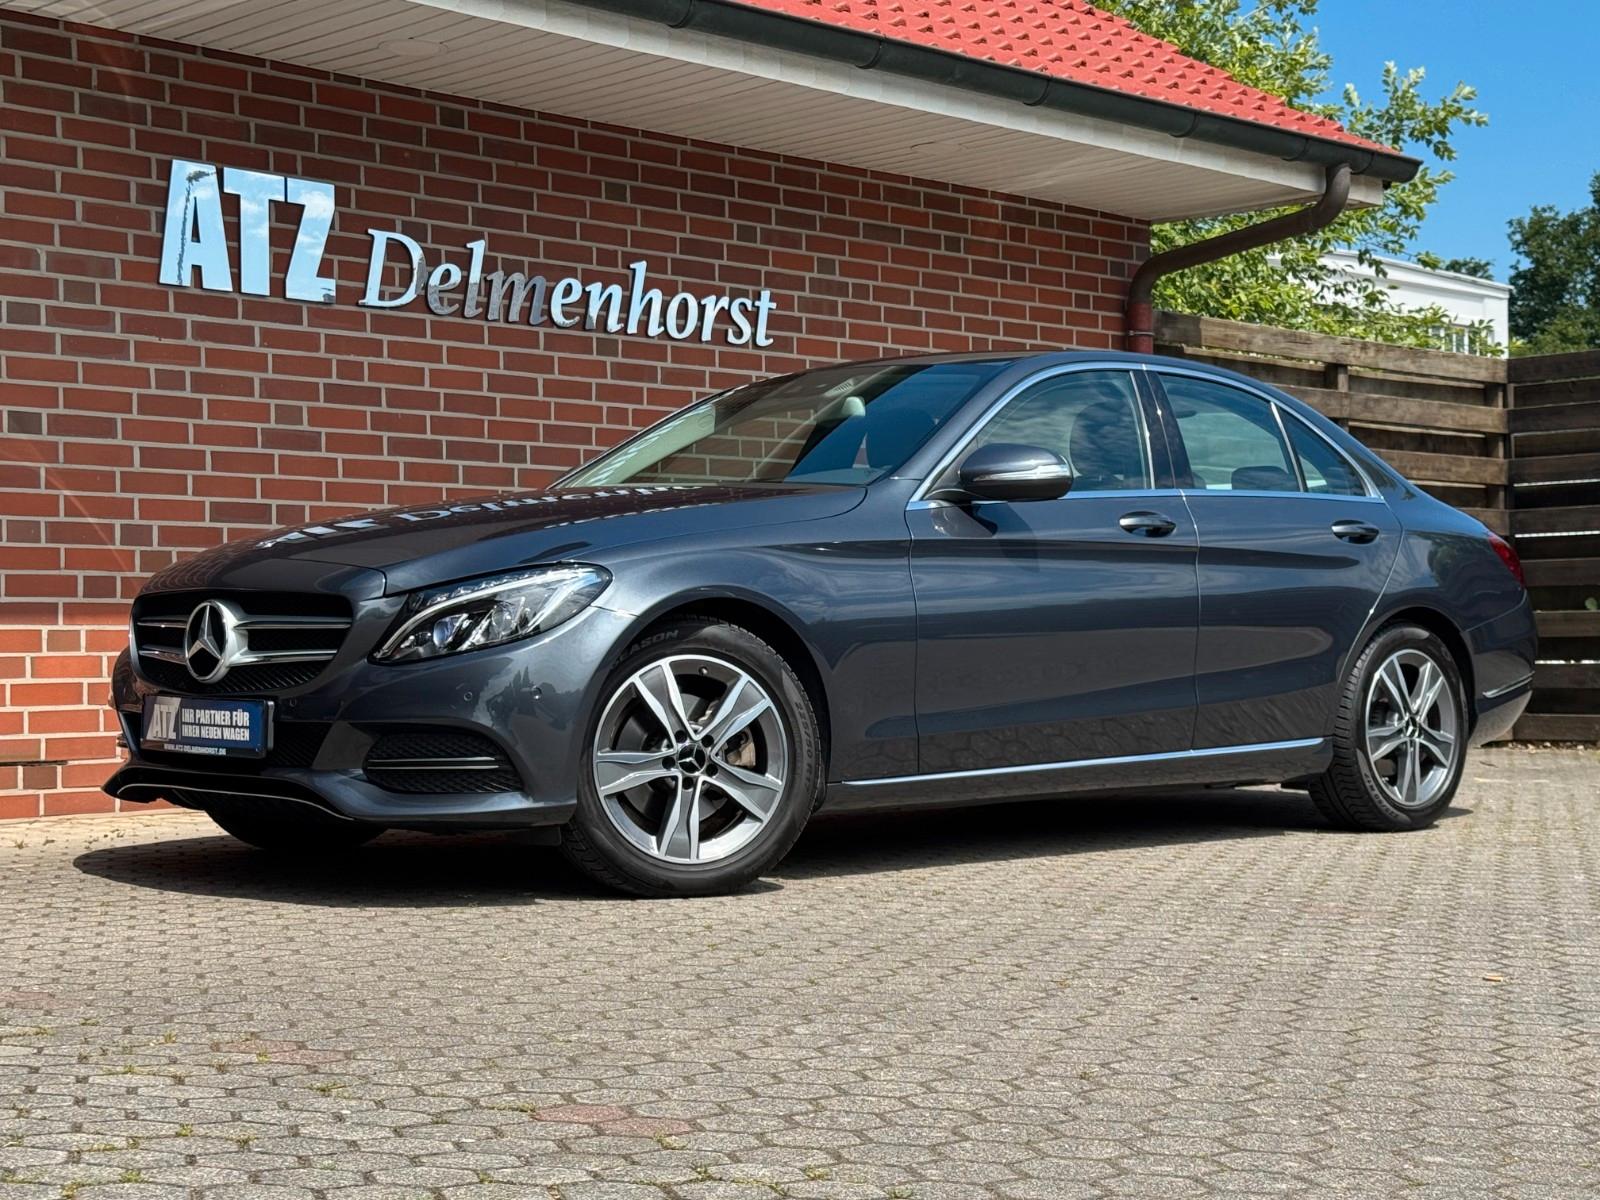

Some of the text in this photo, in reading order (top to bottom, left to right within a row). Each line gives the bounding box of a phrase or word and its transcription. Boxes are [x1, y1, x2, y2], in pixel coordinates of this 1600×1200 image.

[159, 158, 778, 348] ATZ Delmenhorst
[149, 703, 177, 740] ATZ
[182, 708, 250, 727] IHR PARTNER FÜR
[181, 724, 250, 742] IHREN NEUEN WAGEN
